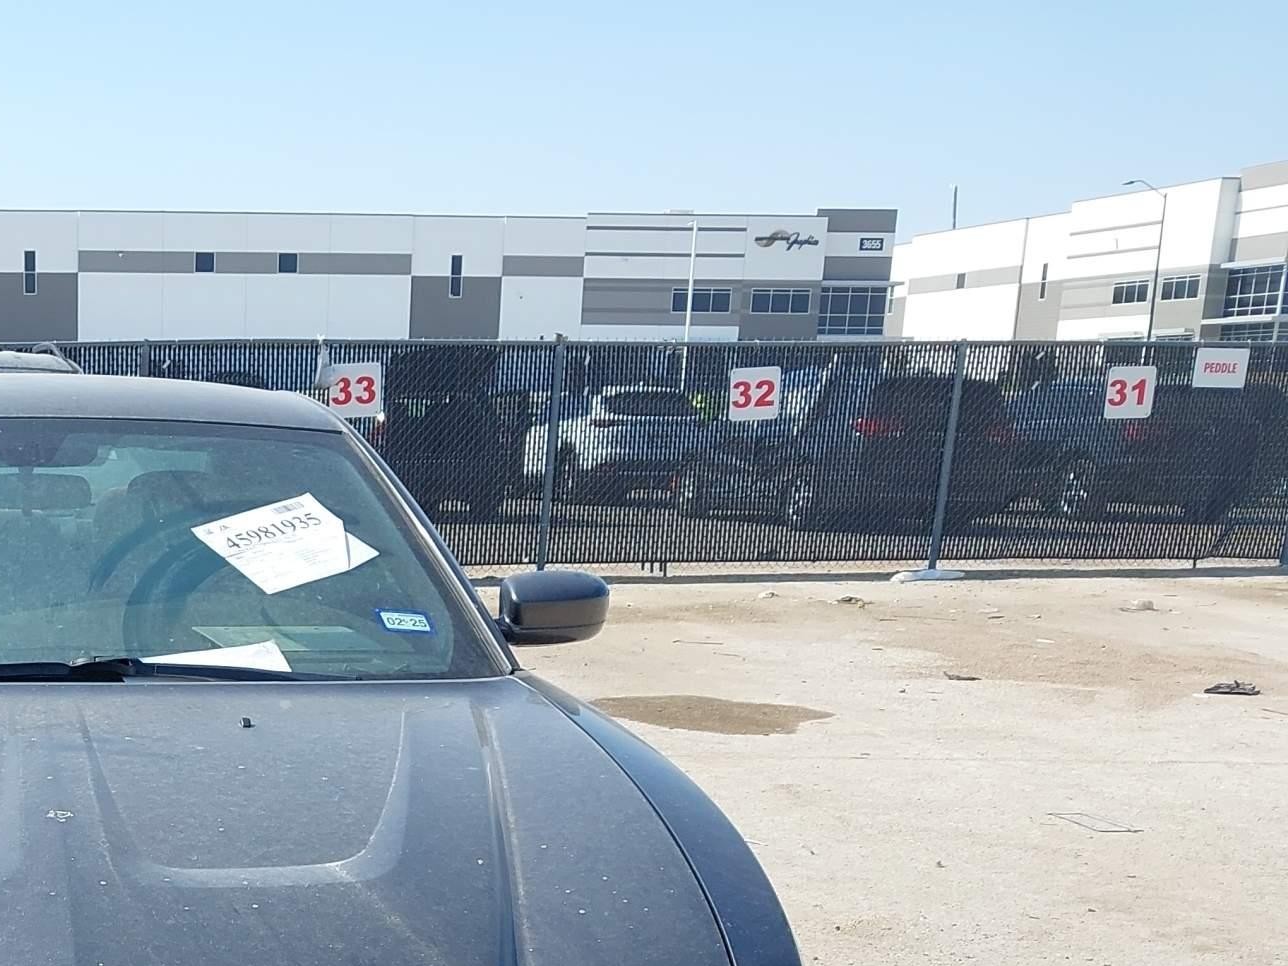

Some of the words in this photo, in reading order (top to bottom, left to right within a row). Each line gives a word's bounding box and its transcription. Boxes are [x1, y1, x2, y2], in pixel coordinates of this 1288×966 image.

[1203, 362, 1239, 374] PEDDLE
[331, 376, 376, 405] 33
[731, 380, 775, 409] 32
[1107, 378, 1147, 407] 31
[225, 512, 322, 549] 45981935
